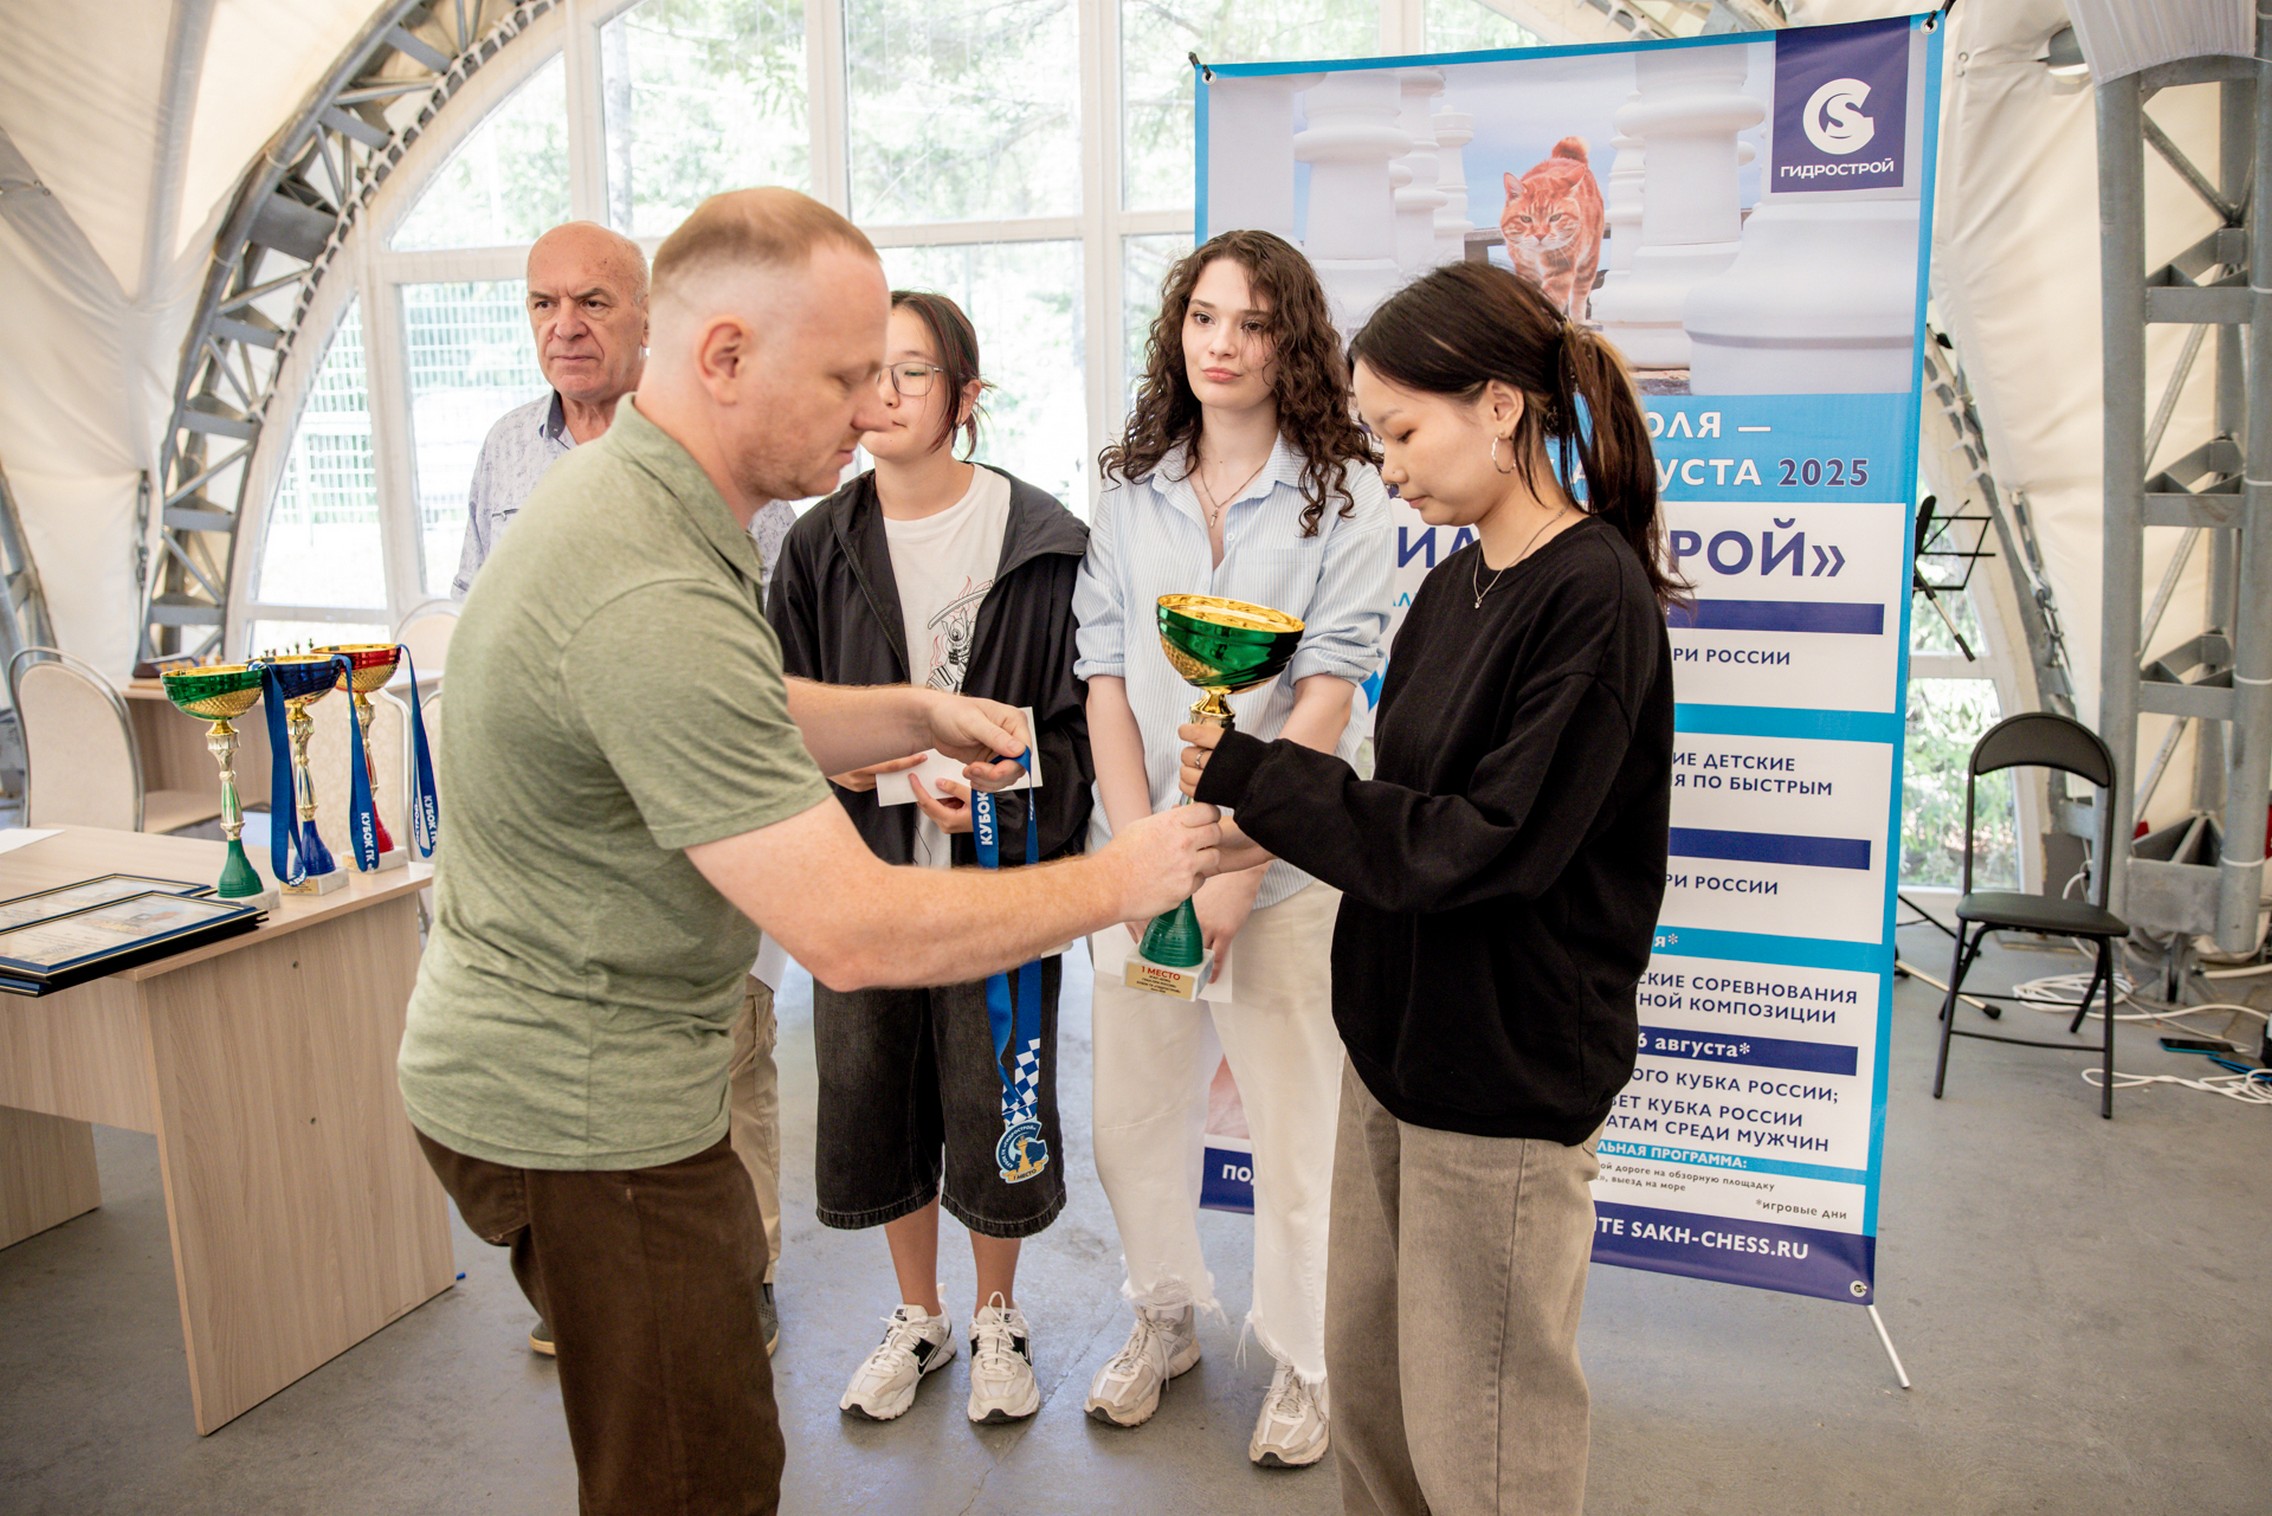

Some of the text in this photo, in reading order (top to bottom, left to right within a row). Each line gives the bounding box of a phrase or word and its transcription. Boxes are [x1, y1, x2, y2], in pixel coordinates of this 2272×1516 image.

[1780, 157, 1894, 179] ГИДРОСТРОЙ
[1777, 457, 1869, 487] 2025
[1706, 649, 1790, 665] РОССИИ
[1703, 754, 1795, 771] ДЕТСКИЕ
[1693, 775, 1722, 789] ПО
[1730, 777, 1832, 796] БЫСТРЫМ
[361, 812, 374, 848] КУБОК
[977, 791, 993, 846] КУБОК
[1695, 876, 1778, 895] РОССИИ
[1147, 967, 1181, 981] МЕСТО
[1692, 976, 1858, 1004] СОРЕВНОВАНИЯ
[1689, 998, 1836, 1024] КОМПОЗИЦИИ
[1676, 1072, 1741, 1092] КУБКА
[1748, 1080, 1838, 1104] РОССИИ;
[1648, 1098, 1712, 1118] КУБКА
[1719, 1105, 1803, 1128] РОССИИ
[1605, 1114, 1829, 1152] АТАМ СРЕДИ МУЖЧИН
[1651, 1147, 1748, 1169] ПРОГРАММА:
[1611, 1176, 1643, 1188] выезд
[1660, 1183, 1687, 1193] море
[1615, 1164, 1651, 1175] дороге
[1668, 1170, 1719, 1184] обзорную
[1722, 1177, 1775, 1193] площадку
[1821, 1209, 1848, 1220] дни
[1631, 1221, 1809, 1260] SAKH-CHESS.RU
